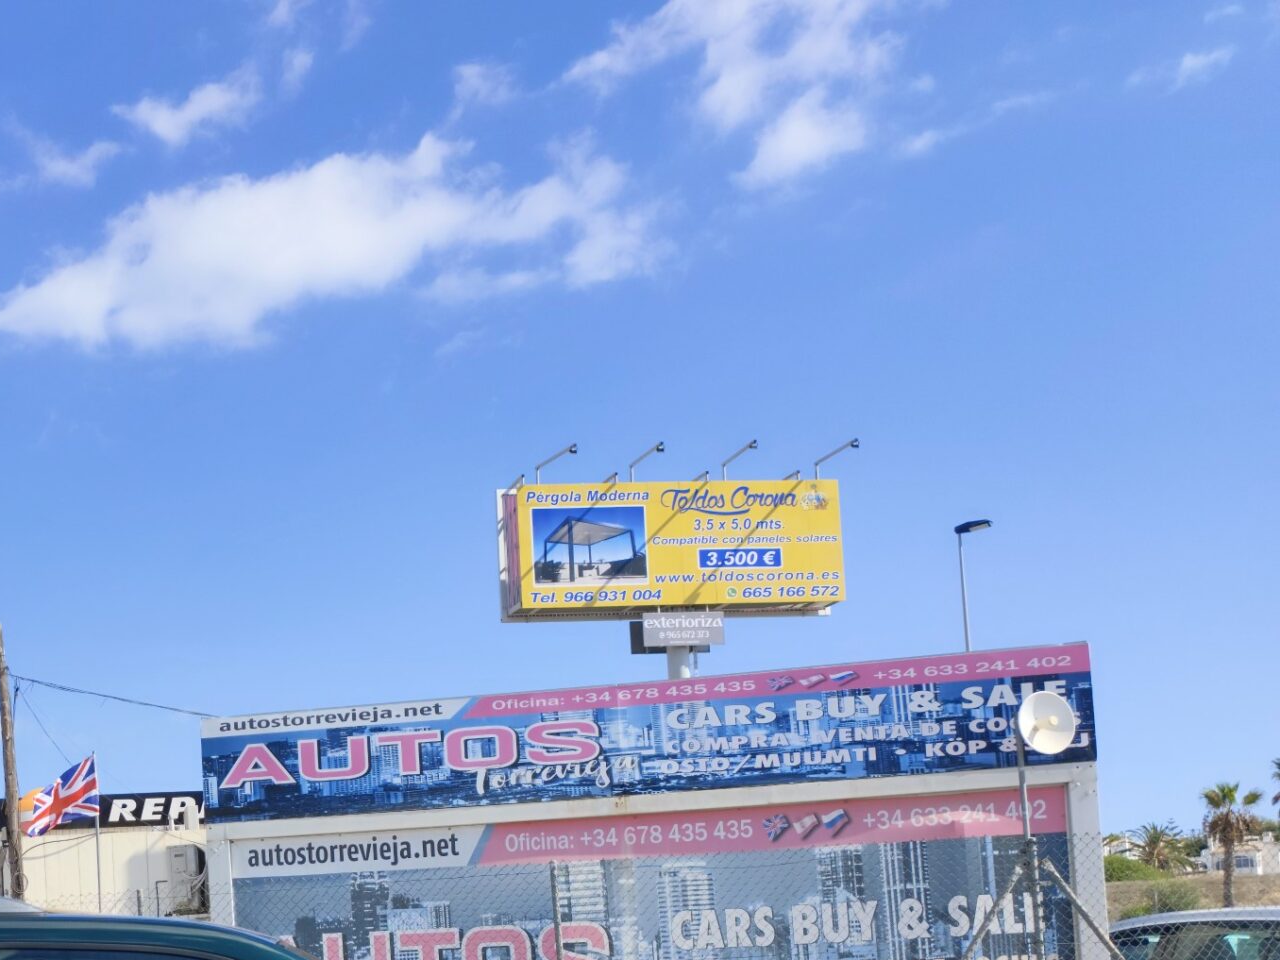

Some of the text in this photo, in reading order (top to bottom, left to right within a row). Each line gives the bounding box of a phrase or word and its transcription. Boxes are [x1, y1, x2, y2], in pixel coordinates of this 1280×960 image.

[526, 490, 649, 505] Pérgola Moderna
[661, 486, 797, 513] Toldos Corona
[693, 518, 714, 531] 3,5
[718, 521, 726, 530] x
[731, 518, 751, 531] 5,0
[652, 534, 838, 546] Compatible con paneles solares
[706, 551, 776, 566] 3.500 €
[655, 571, 840, 583] www.toldoscorona.es
[530, 590, 662, 603] Tel. 966 931 004
[742, 585, 840, 598] 665 166 572
[873, 655, 1072, 681] +34 633 241 402
[492, 680, 756, 711] Oficina: +34 678 435 435
[220, 703, 443, 732] autostorrevieja.net
[667, 702, 777, 729] CARS
[795, 693, 888, 720] BUY
[909, 690, 943, 713] &
[668, 731, 791, 754] COMPRA
[818, 724, 910, 744] VENTA
[921, 720, 957, 737] DE
[925, 737, 987, 757] KÖP
[219, 720, 602, 789] AUTOS
[863, 809, 904, 830] +34
[910, 806, 953, 827] 633
[959, 803, 1000, 824] 241
[505, 819, 753, 853] Oficina: +34 678 435 435
[248, 833, 459, 867] autostorrevieja.net
[671, 906, 776, 950] CARS
[791, 900, 878, 945] BUY
[898, 898, 931, 940] &
